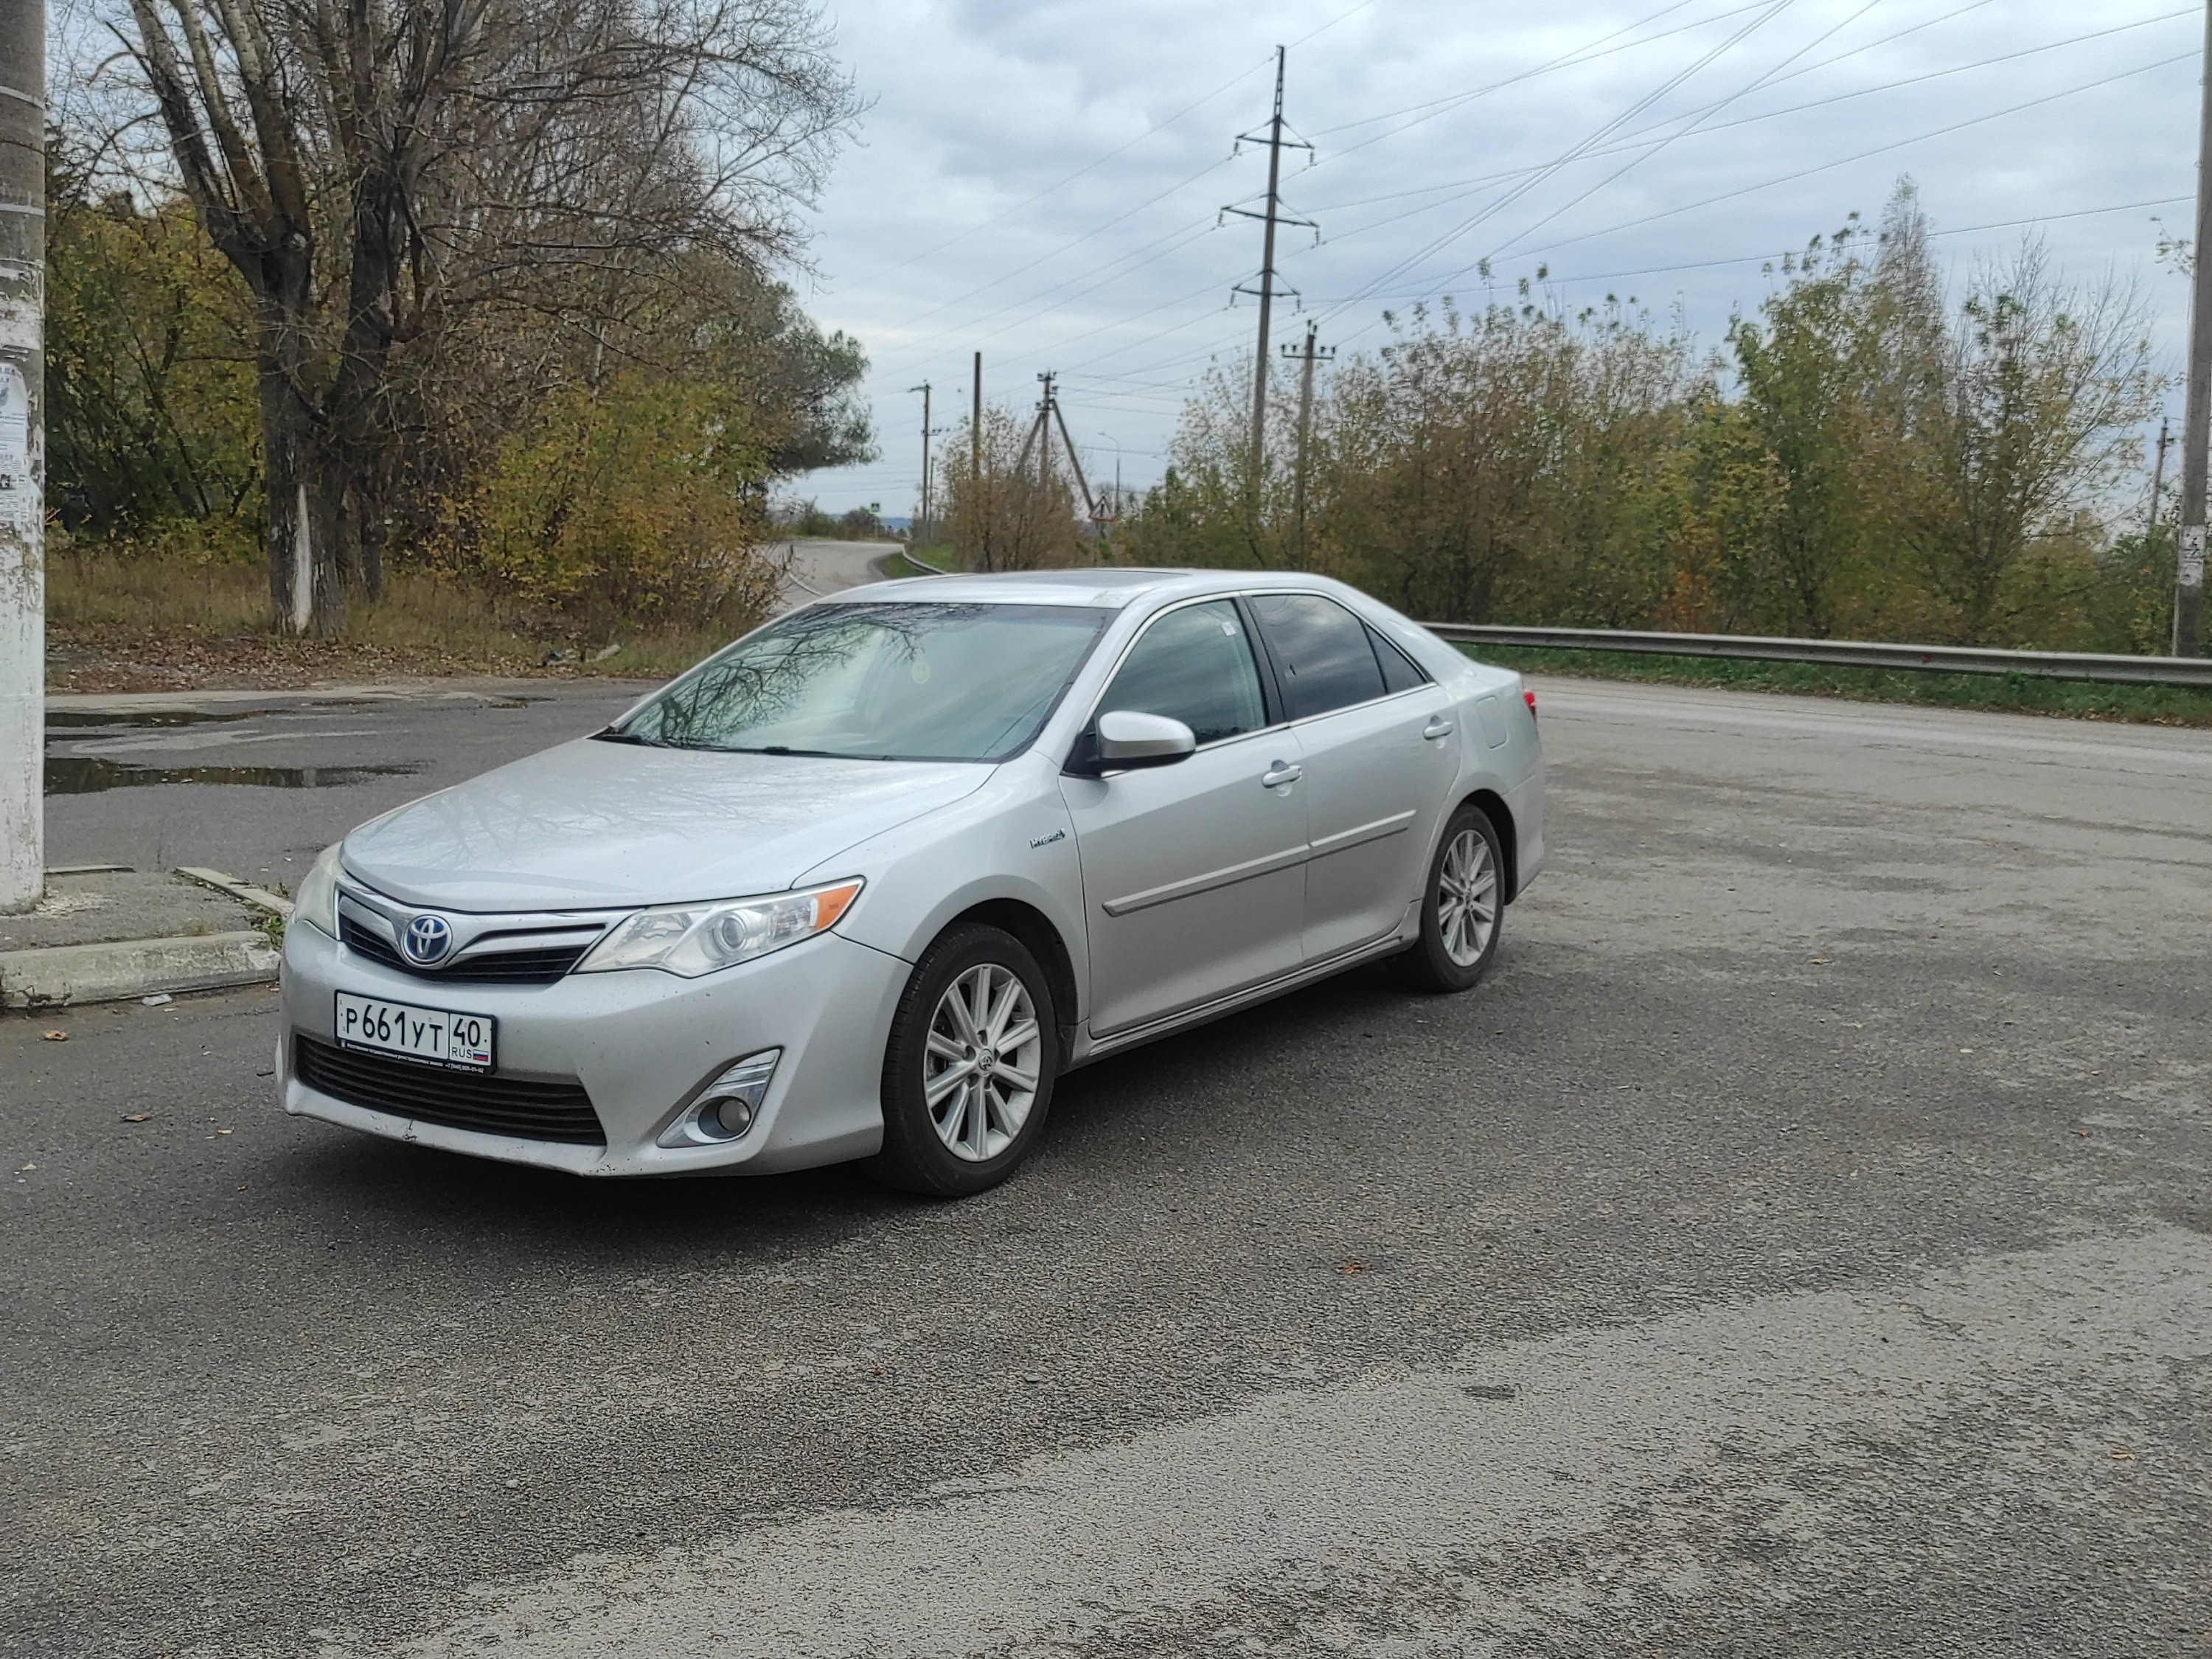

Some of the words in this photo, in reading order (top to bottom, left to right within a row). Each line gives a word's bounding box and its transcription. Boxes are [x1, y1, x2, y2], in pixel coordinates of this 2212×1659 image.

[347, 1004, 443, 1052] Р661УТ
[453, 1018, 481, 1048] 40
[451, 1046, 473, 1060] RUS
